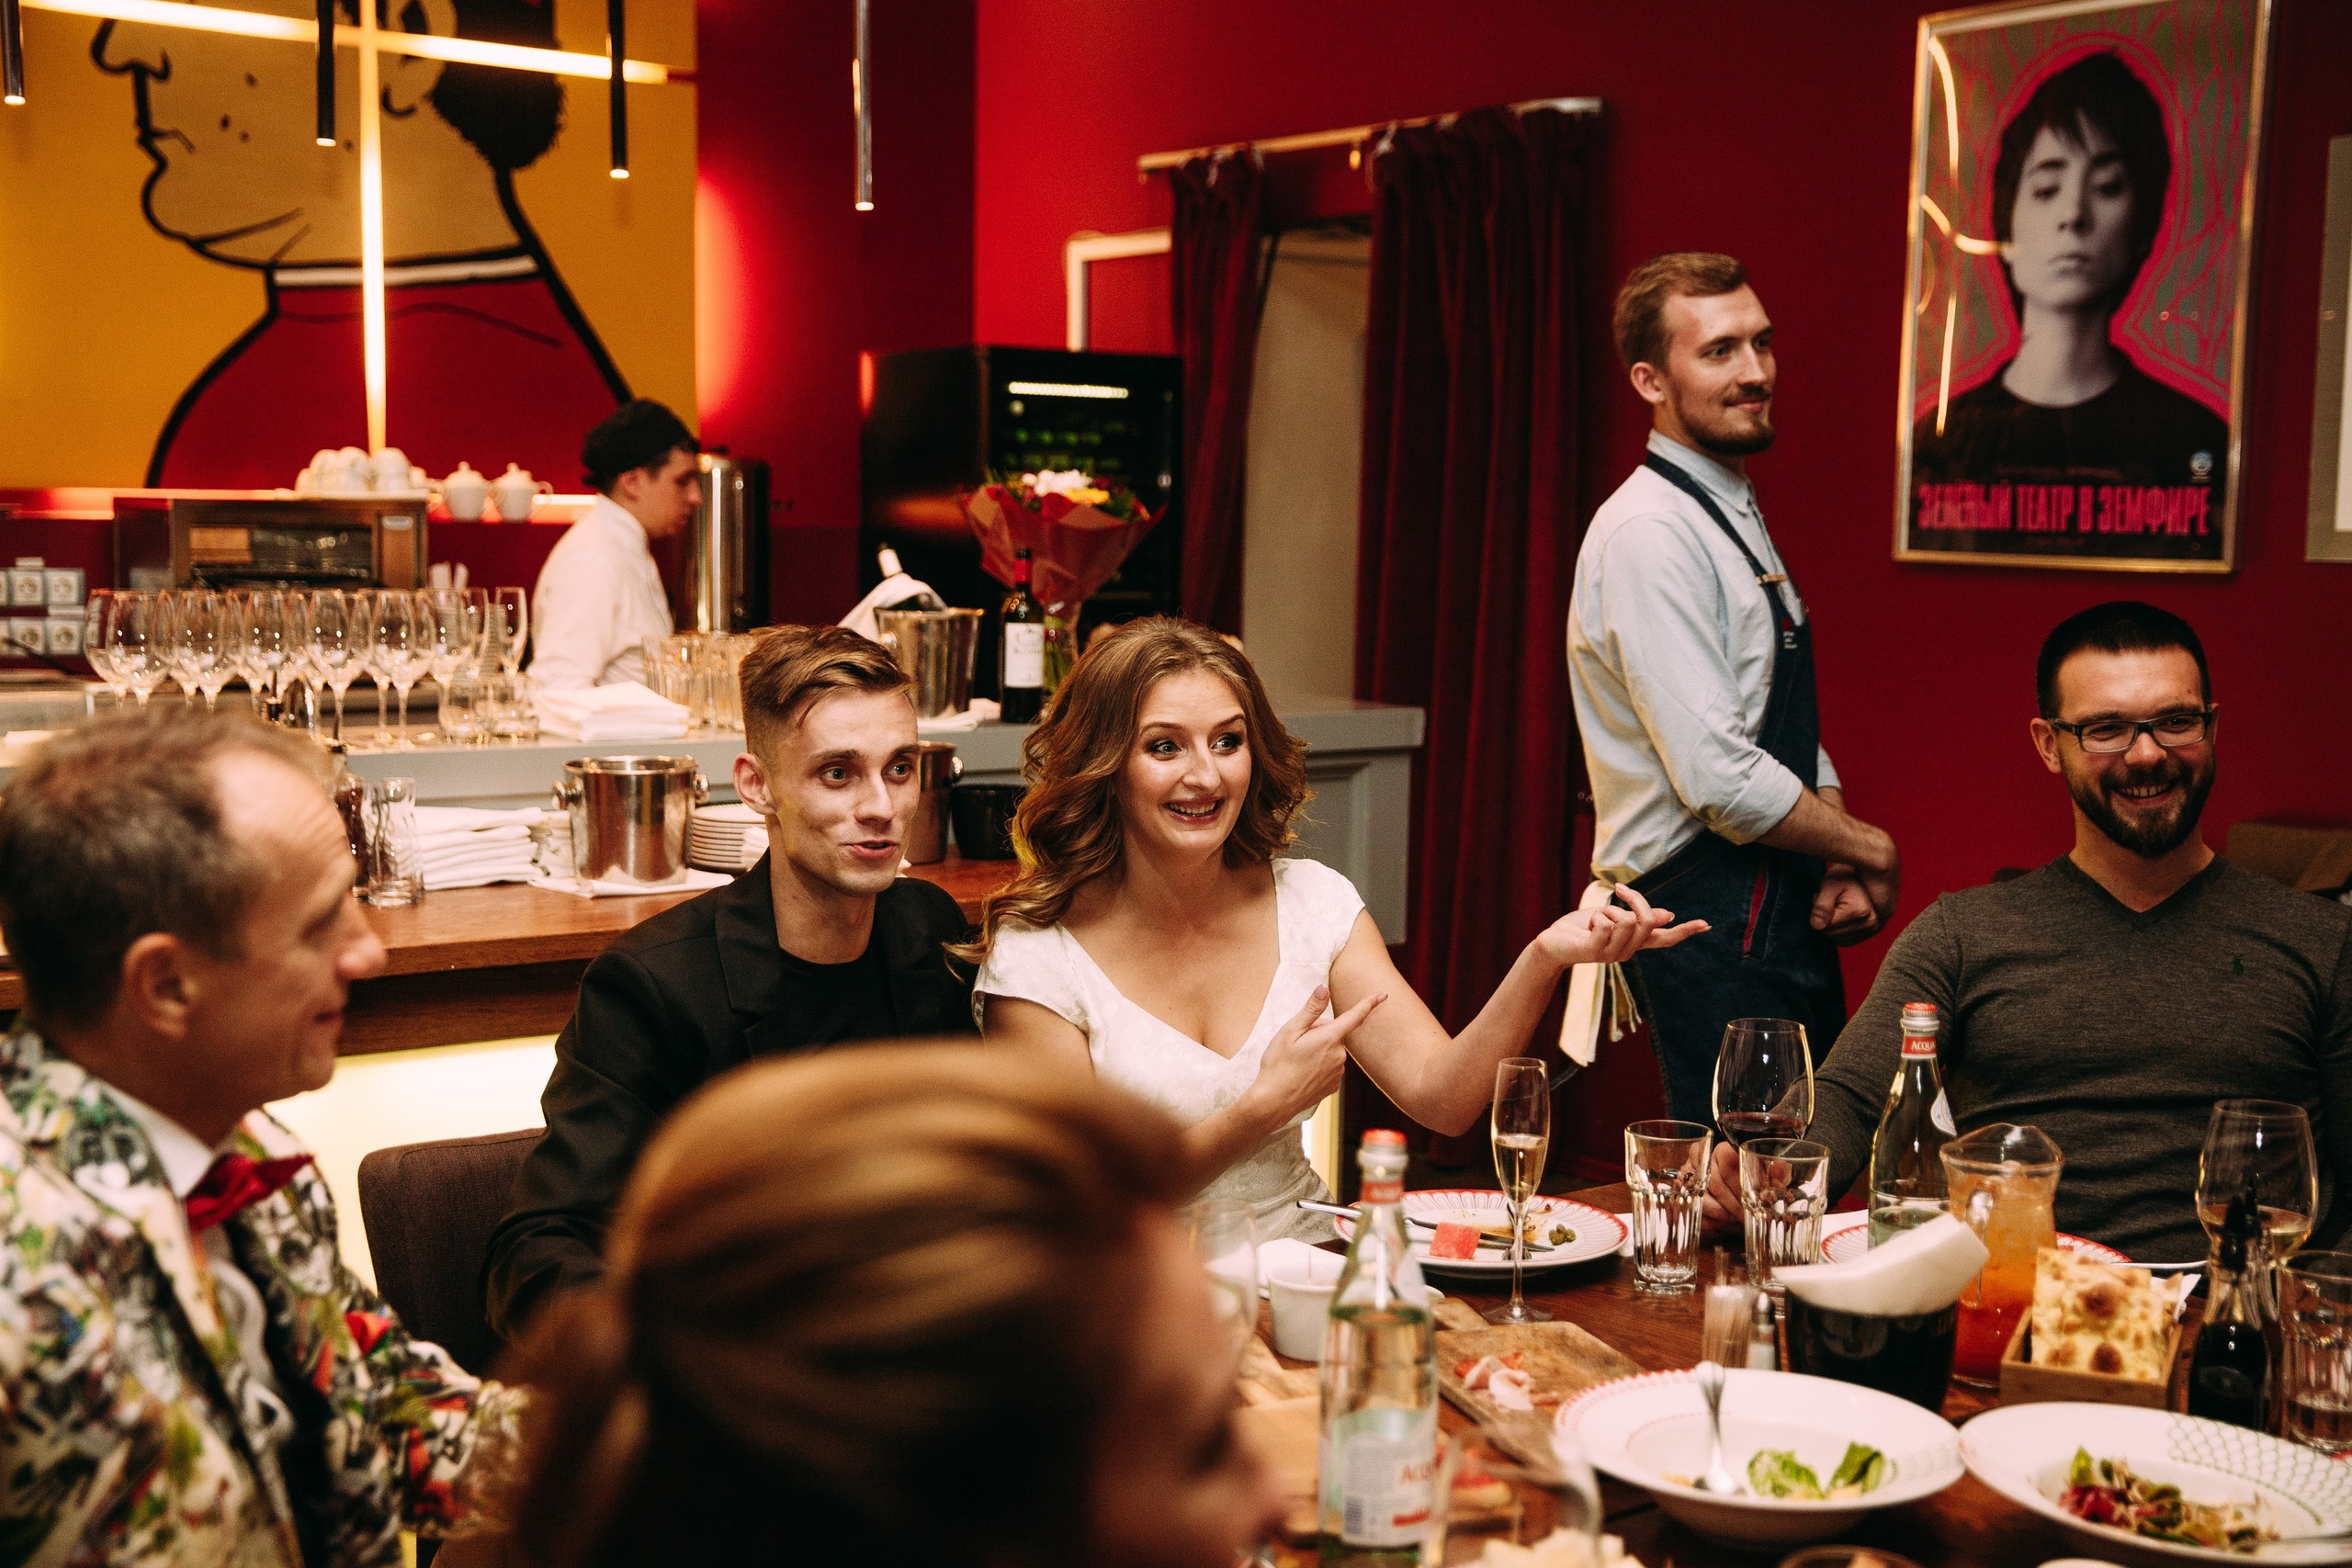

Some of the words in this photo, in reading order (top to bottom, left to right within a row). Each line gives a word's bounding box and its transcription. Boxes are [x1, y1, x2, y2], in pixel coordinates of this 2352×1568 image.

[2017, 484, 2075, 532] ТЕАТР
[2098, 485, 2211, 536] ЗЕМФИРЕ
[1911, 1041, 1936, 1051] ACQUA
